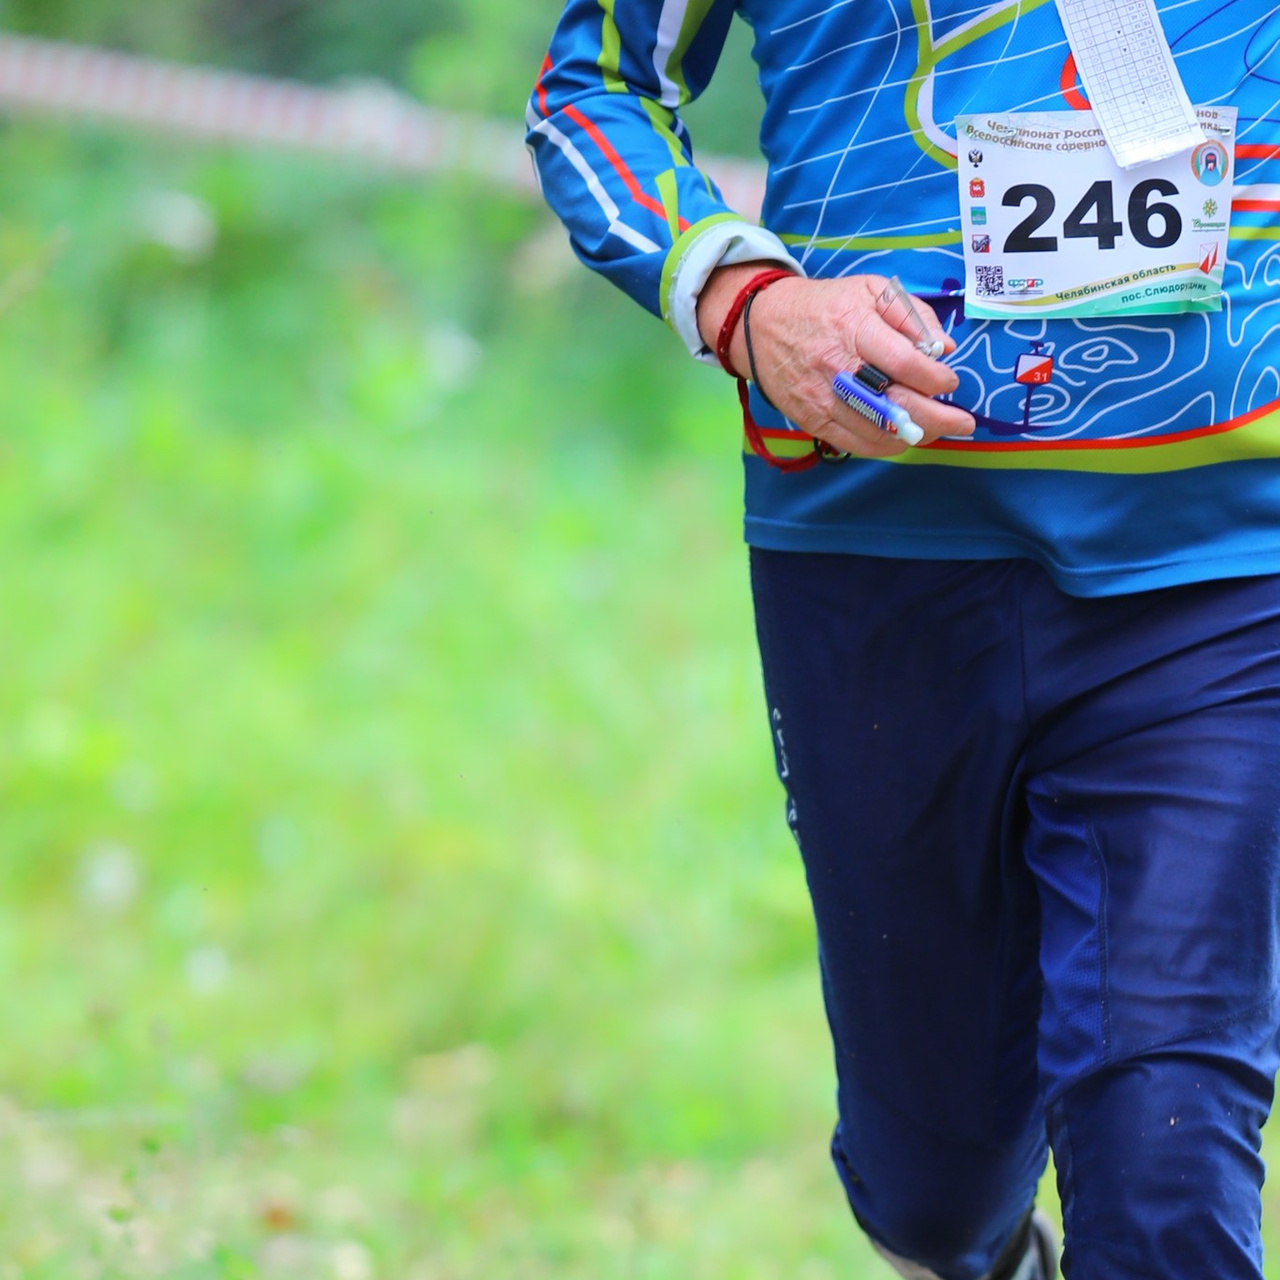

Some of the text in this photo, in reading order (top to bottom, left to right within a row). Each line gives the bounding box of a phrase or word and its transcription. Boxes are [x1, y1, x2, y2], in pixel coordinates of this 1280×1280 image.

[1055, 140, 1106, 153] соревно
[1001, 178, 1182, 253] 246
[1055, 264, 1176, 301] Челябинская область
[1033, 371, 1048, 382] 31
